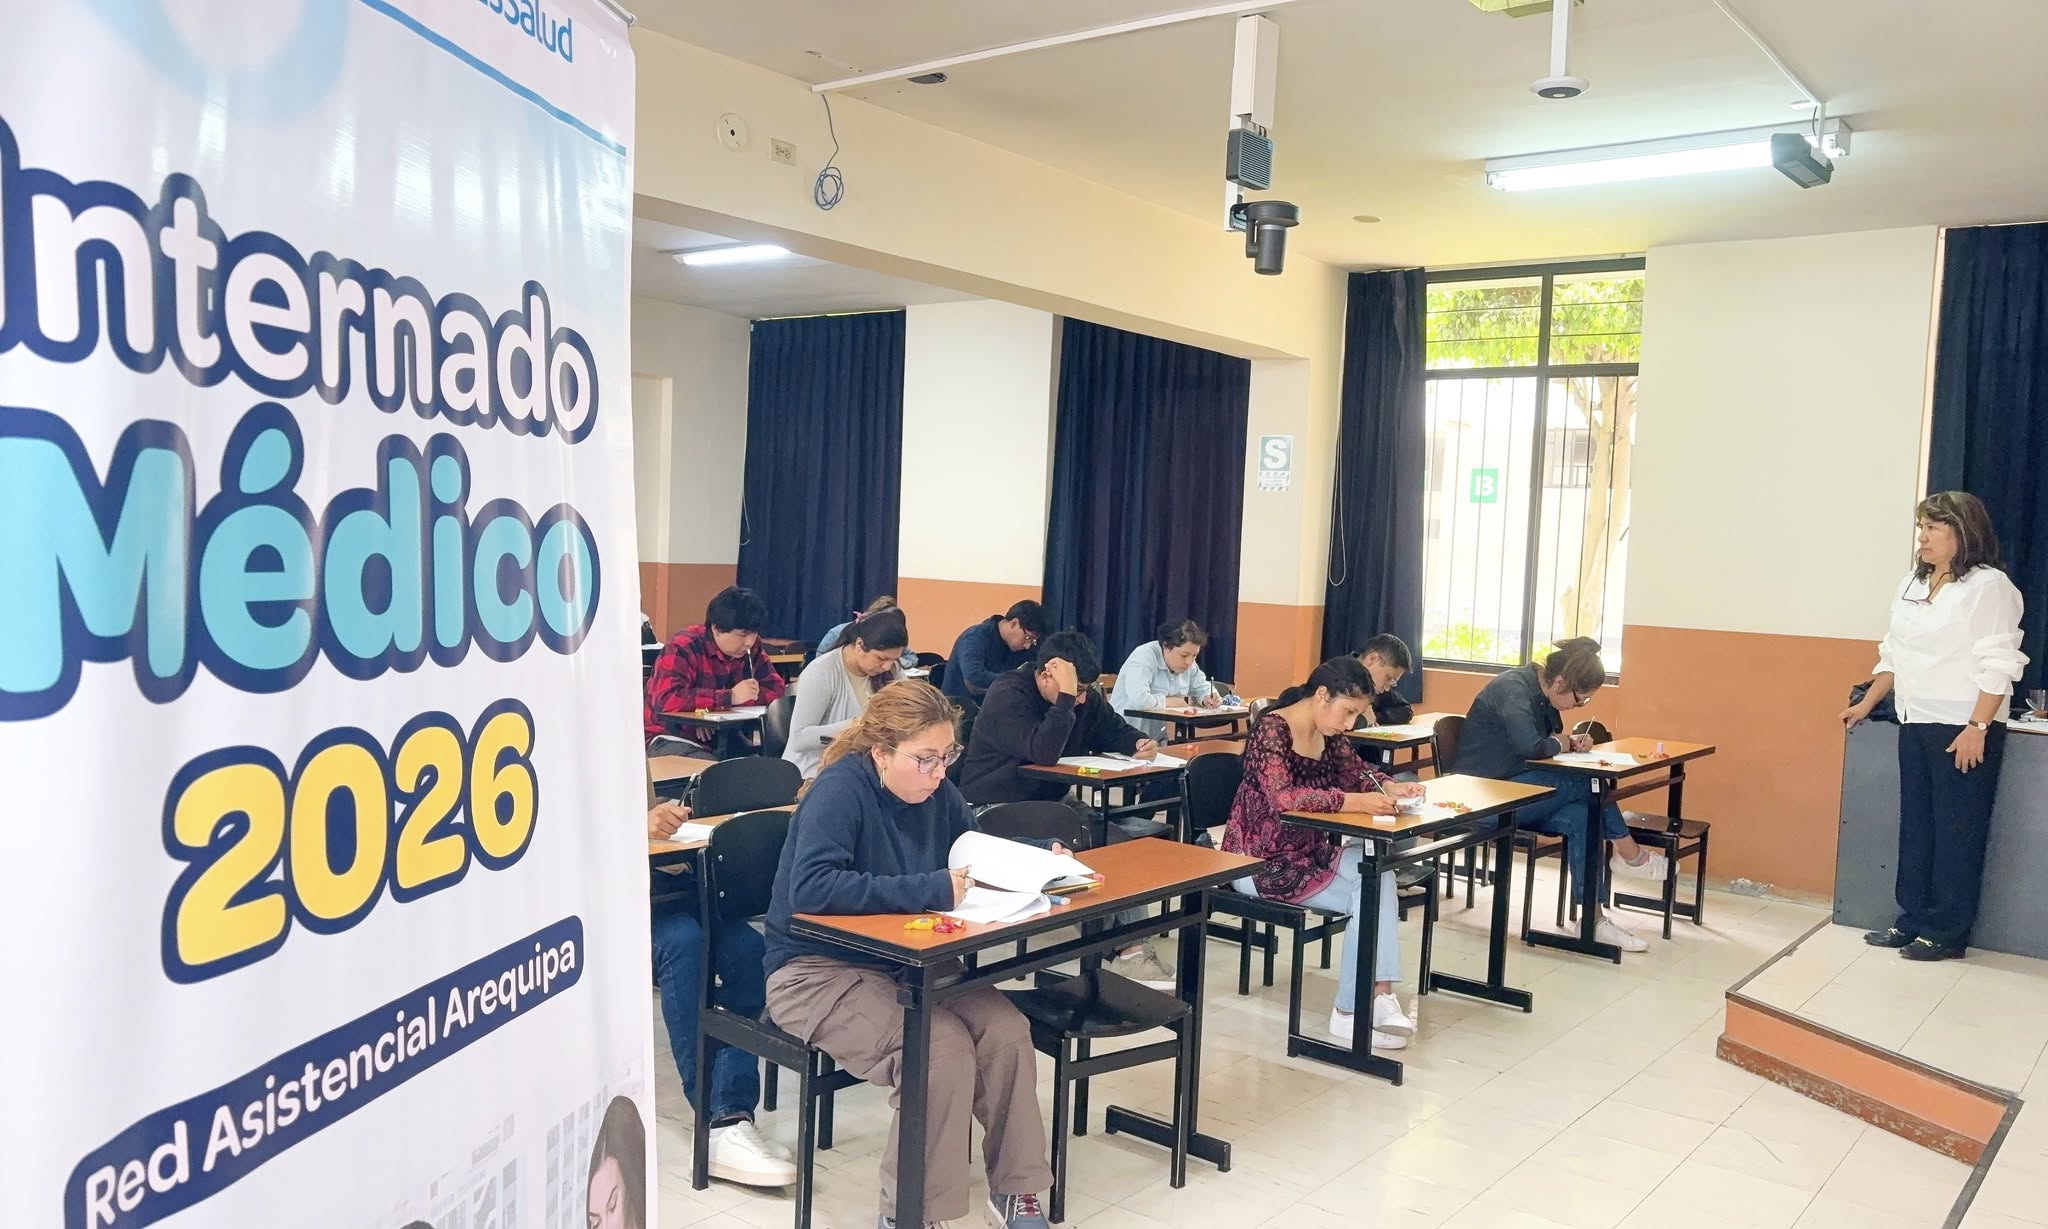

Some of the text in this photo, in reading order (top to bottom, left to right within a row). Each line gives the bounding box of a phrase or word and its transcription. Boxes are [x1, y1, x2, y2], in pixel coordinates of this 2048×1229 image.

[0, 172, 598, 443] nternado
[0, 402, 600, 722] Médico
[1263, 439, 1288, 469] S
[1475, 475, 1495, 497] B
[162, 698, 538, 984] 2026
[85, 940, 576, 1229] Red Asistencial Arequipa
